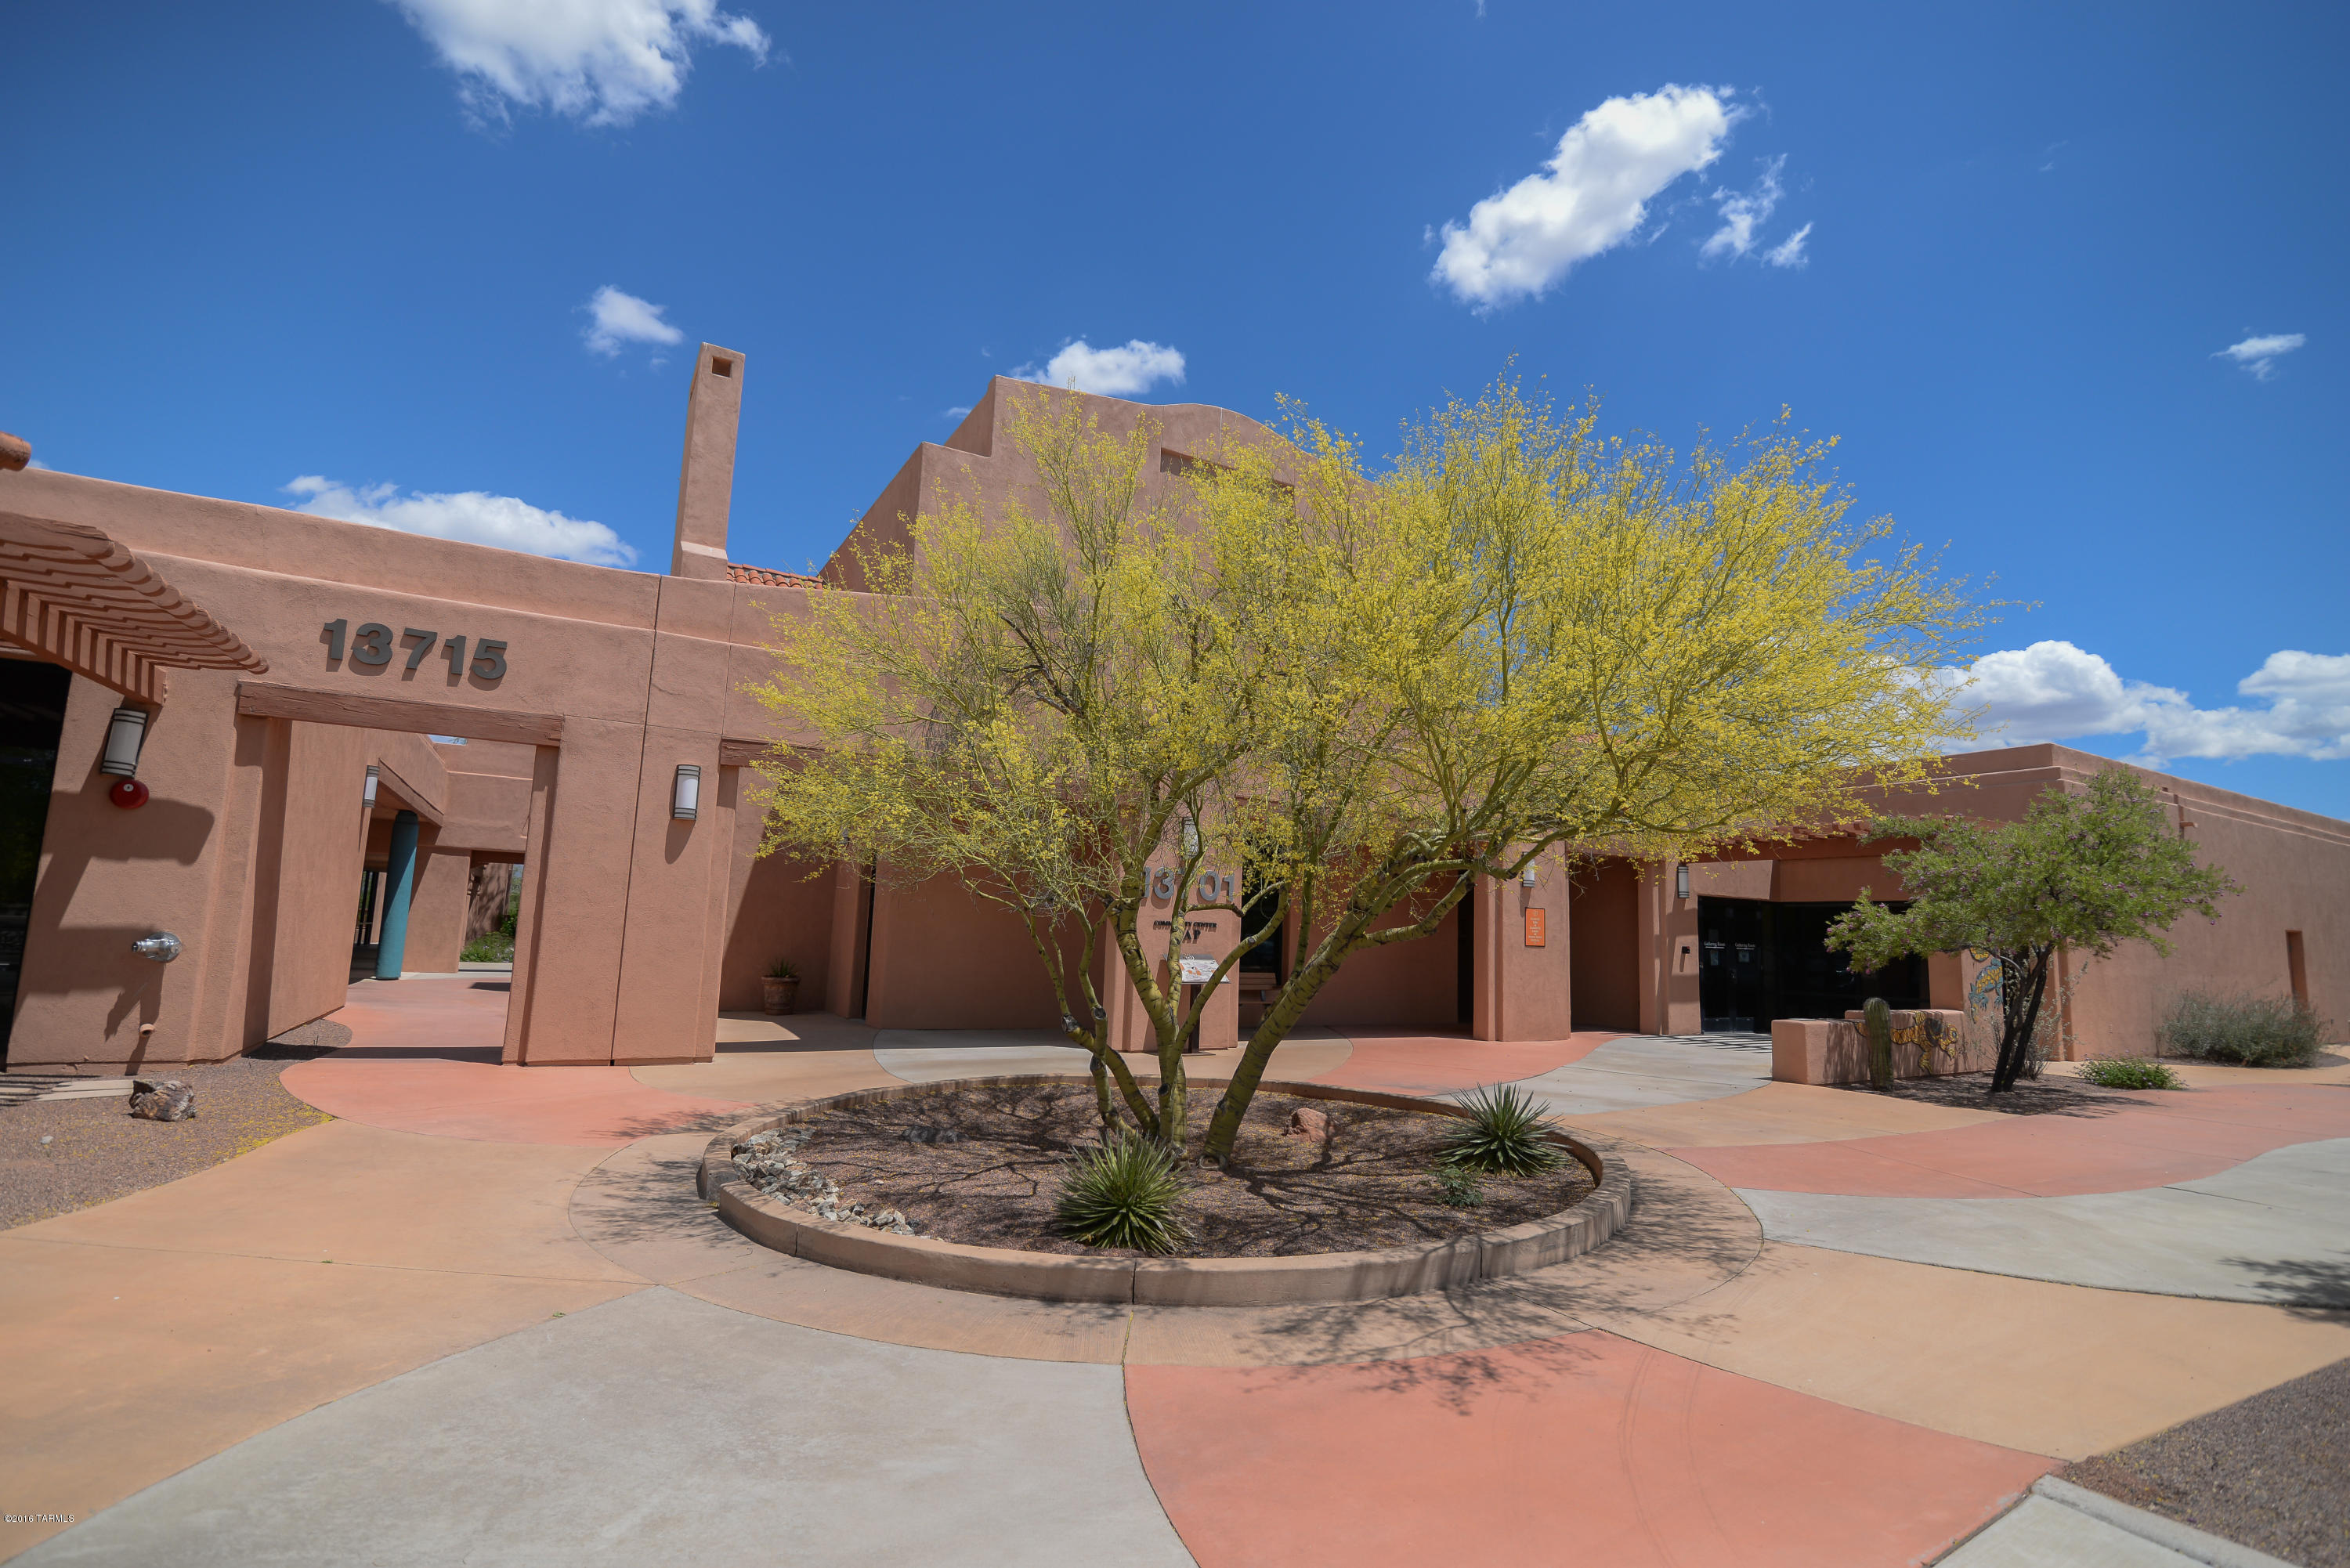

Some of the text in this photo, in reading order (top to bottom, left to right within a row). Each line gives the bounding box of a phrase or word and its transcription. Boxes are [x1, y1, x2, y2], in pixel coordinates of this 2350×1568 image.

[324, 619, 508, 680] 13715
[1144, 866, 1235, 903] 1301
[1183, 930, 1201, 940] AP
